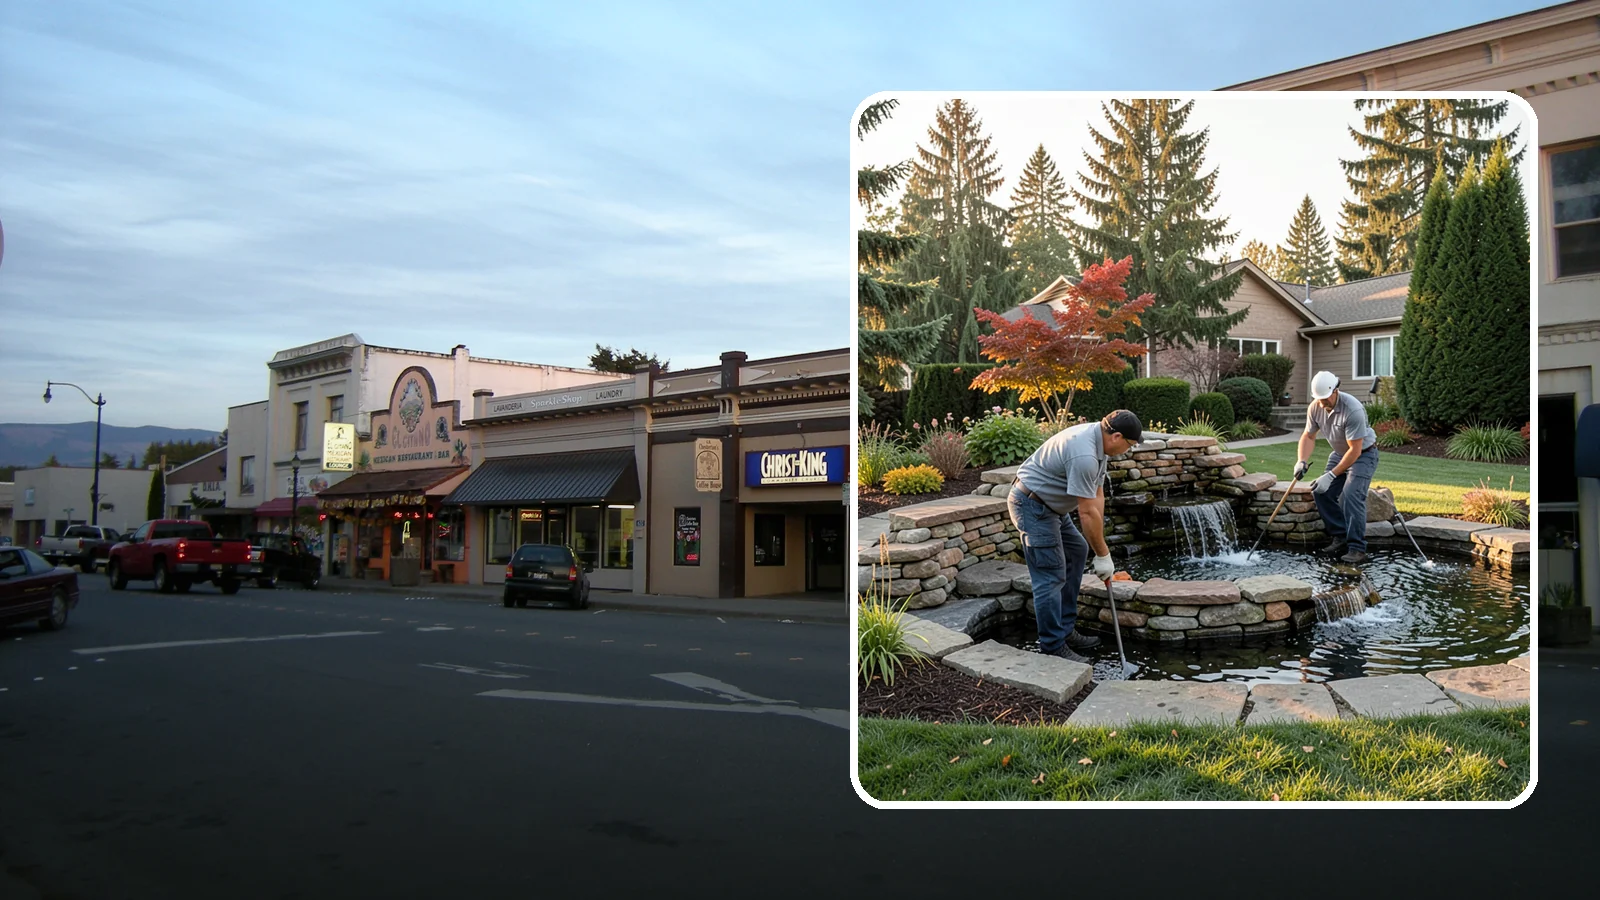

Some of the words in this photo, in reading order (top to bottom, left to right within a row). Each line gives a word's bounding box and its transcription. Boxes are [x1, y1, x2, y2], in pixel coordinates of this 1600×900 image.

[595, 389, 623, 400] LAUNDRY
[493, 402, 522, 412] LAVANDERIA
[398, 451, 433, 462] RESTAURANT
[438, 450, 450, 459] BAR
[761, 452, 797, 478] CHRIST
[799, 450, 827, 476] KING
